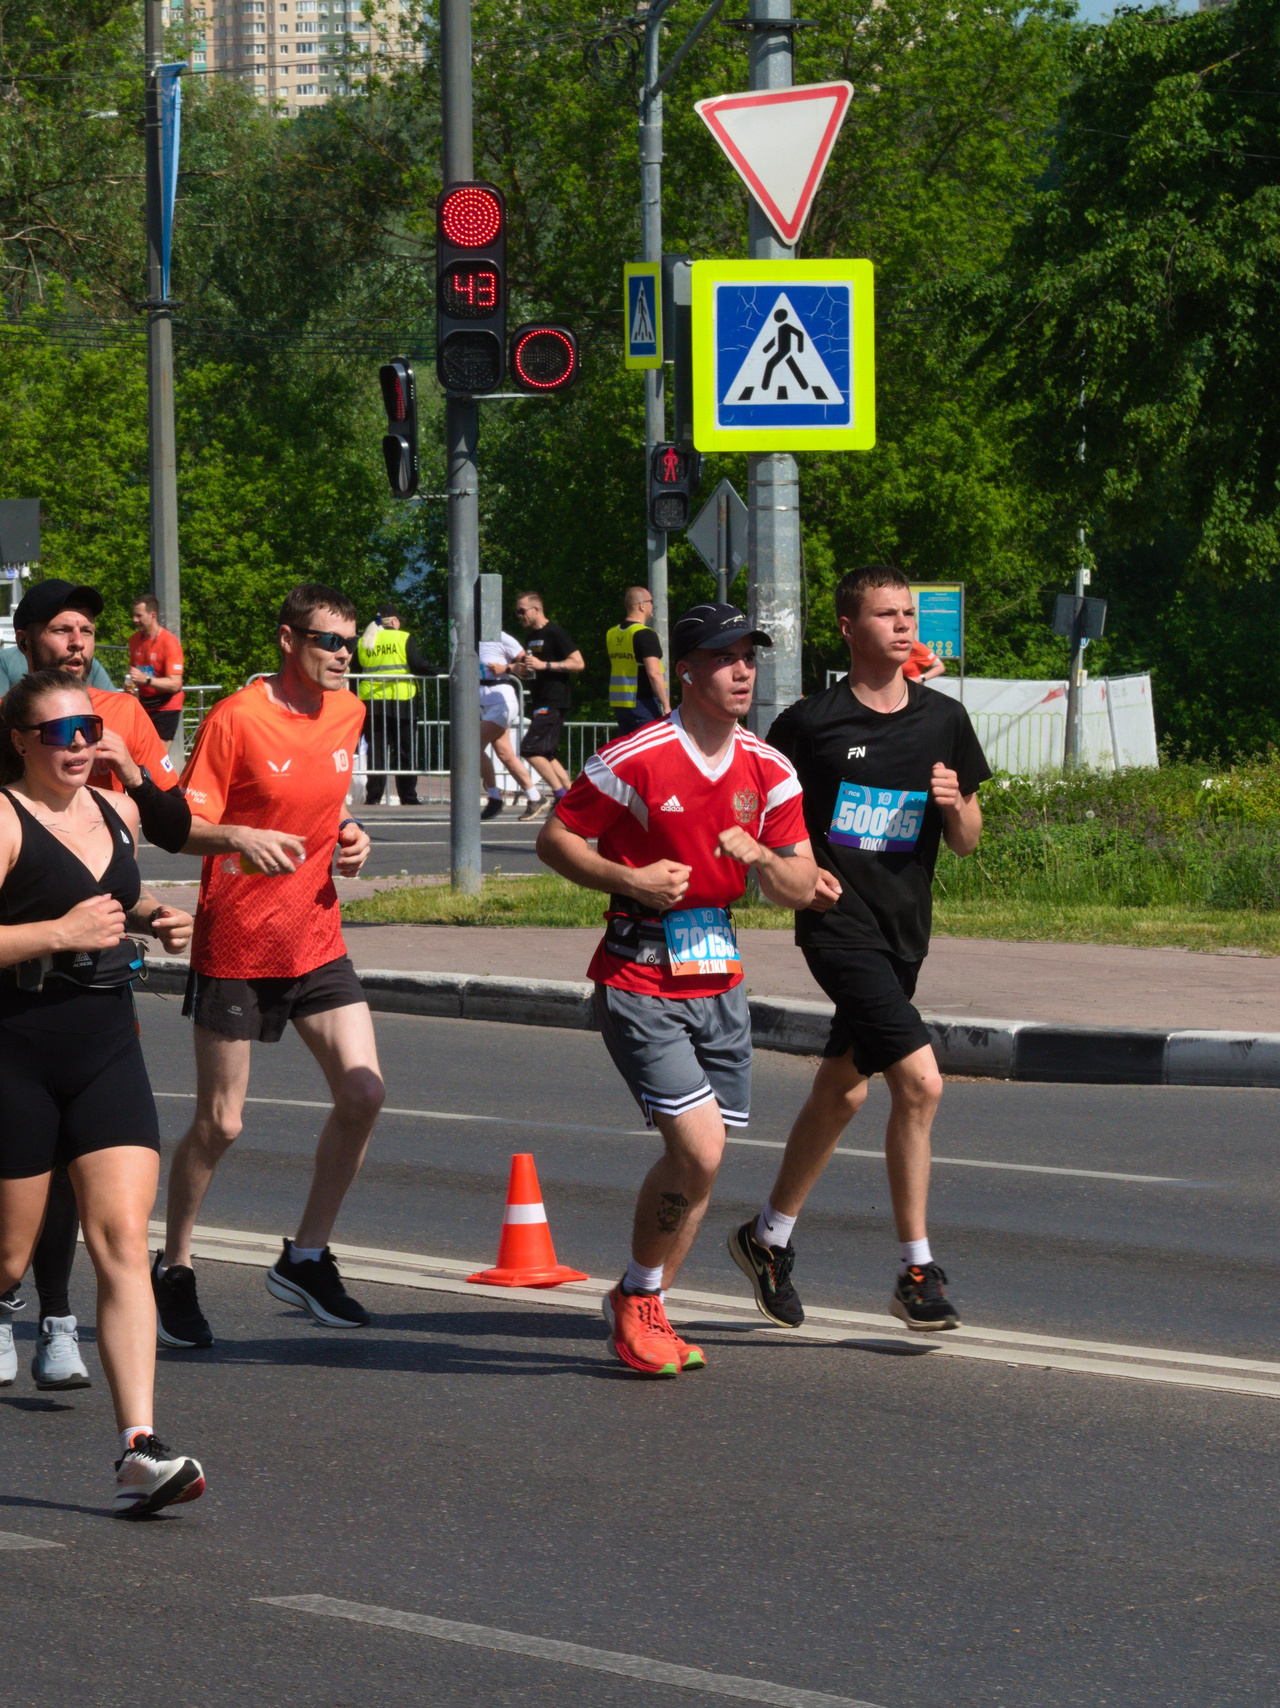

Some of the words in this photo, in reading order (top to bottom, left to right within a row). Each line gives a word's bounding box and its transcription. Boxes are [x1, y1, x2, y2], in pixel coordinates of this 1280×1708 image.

[454, 272, 496, 306] 43
[847, 746, 866, 759] FN
[661, 805, 684, 813] adidas
[836, 800, 919, 839] 50085
[674, 925, 735, 959] 70153
